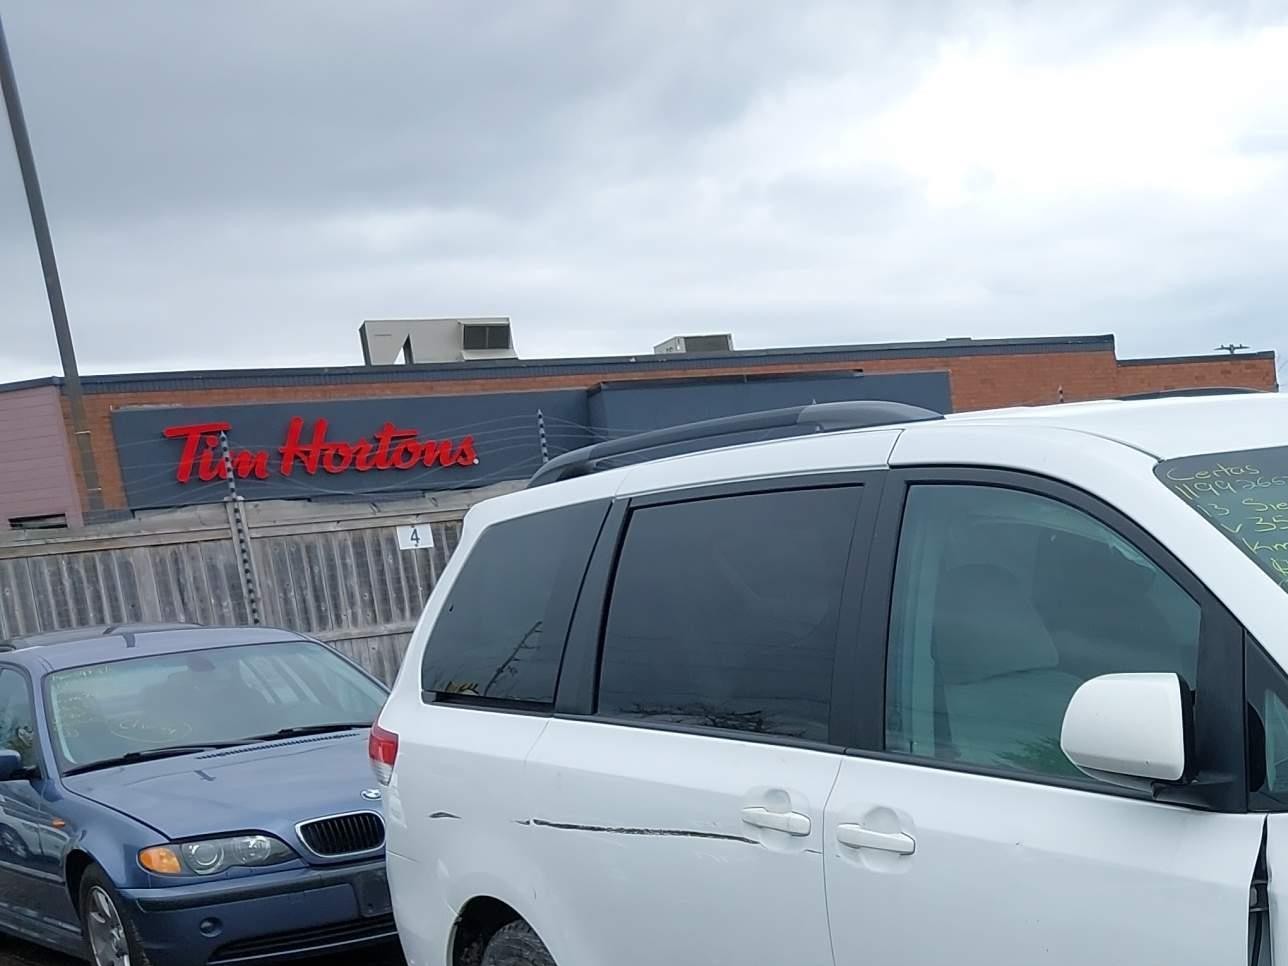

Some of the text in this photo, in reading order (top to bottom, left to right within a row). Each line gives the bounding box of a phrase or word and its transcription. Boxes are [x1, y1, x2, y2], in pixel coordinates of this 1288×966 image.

[163, 416, 478, 484] Tim Hortons
[410, 528, 421, 544] 4
